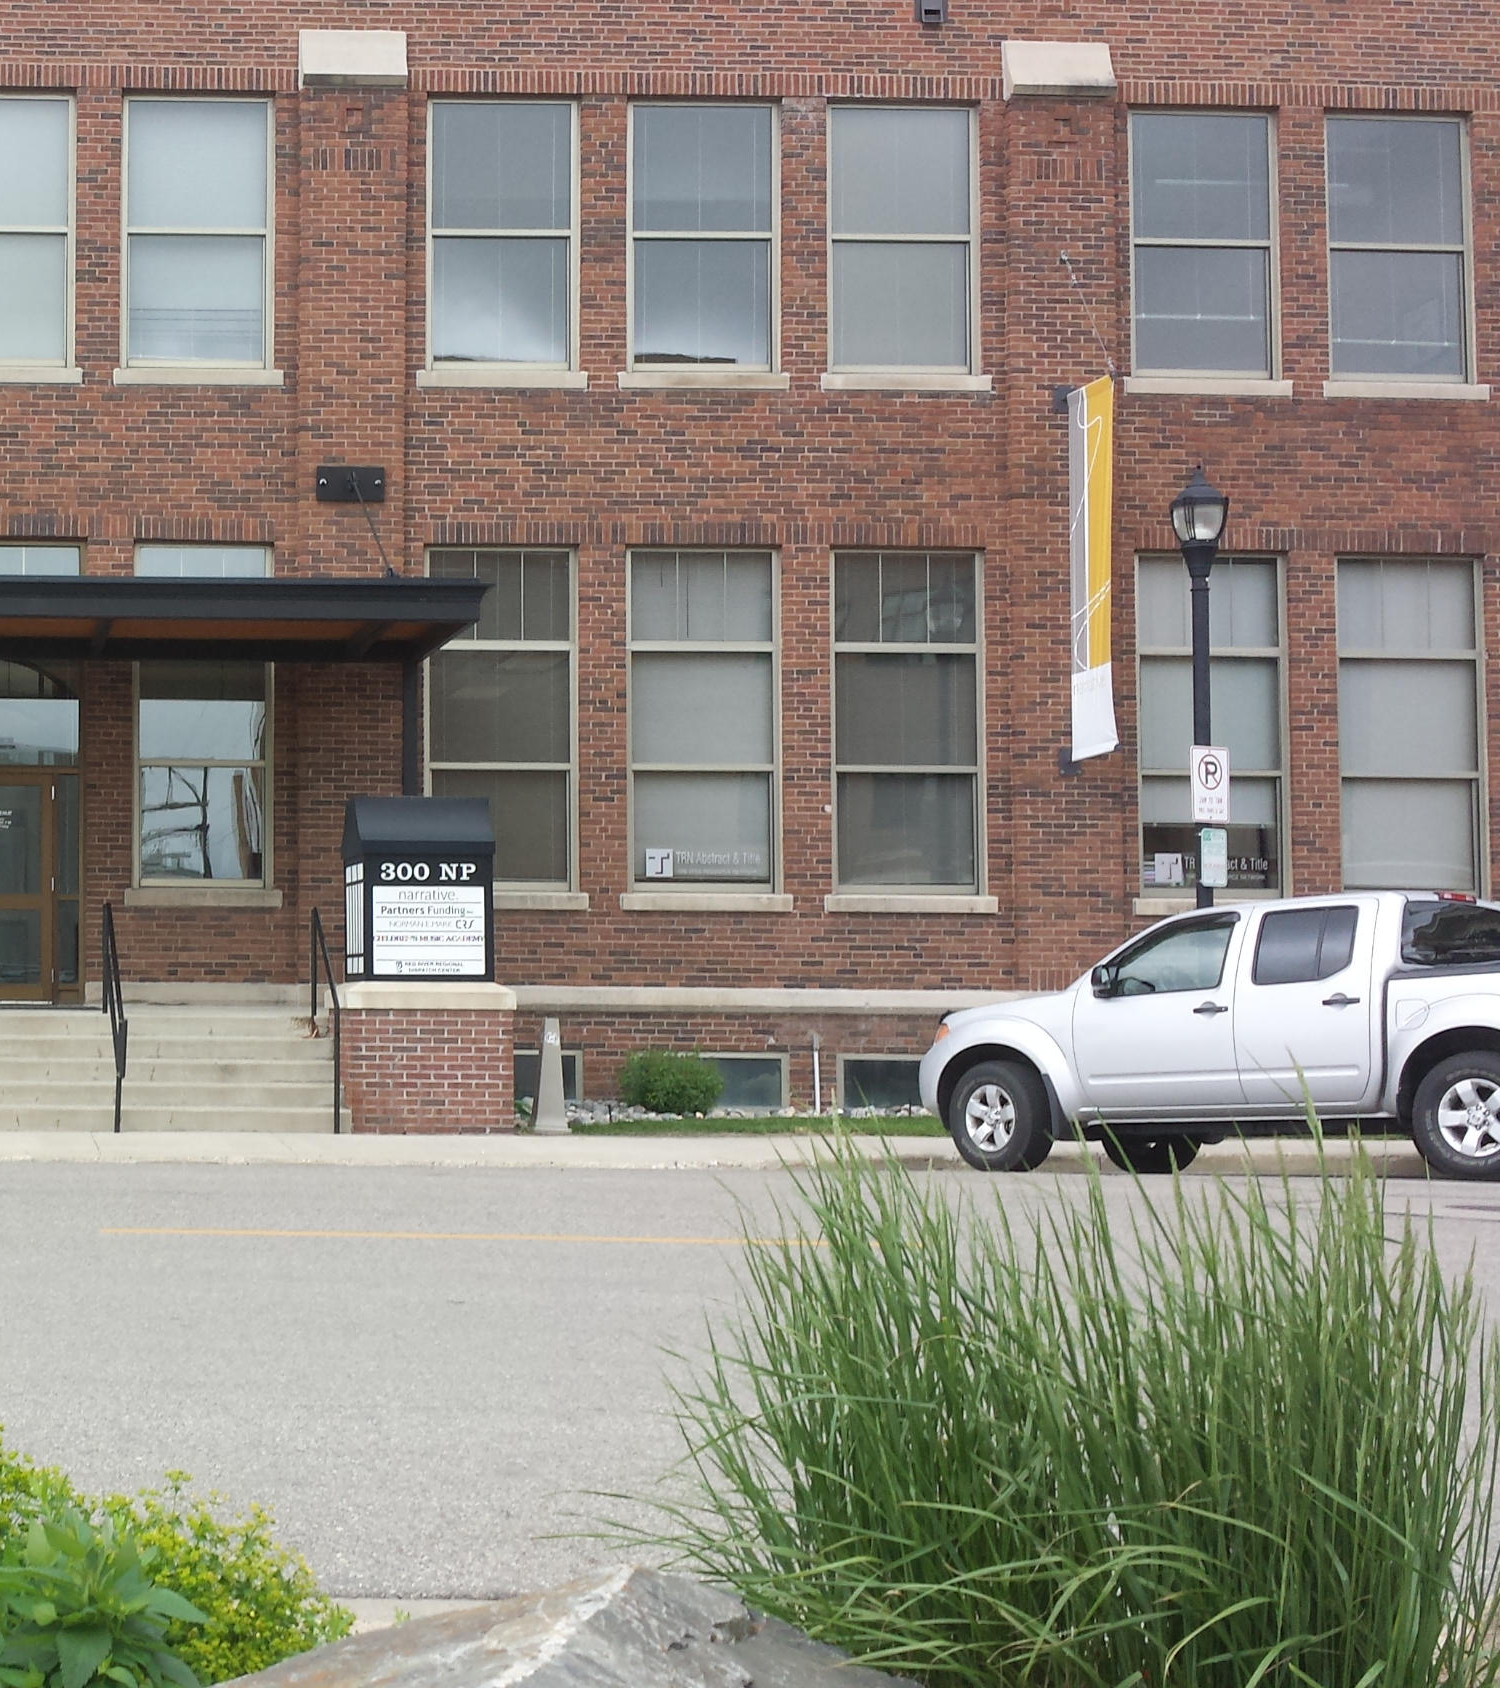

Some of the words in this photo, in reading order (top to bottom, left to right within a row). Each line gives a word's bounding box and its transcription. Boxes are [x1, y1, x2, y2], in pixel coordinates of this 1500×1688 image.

[675, 852, 694, 864] TRN
[1250, 857, 1268, 870] Title
[380, 862, 430, 881] 300
[439, 863, 477, 881] NP
[381, 905, 425, 915] Partners
[427, 905, 465, 917] Funding
